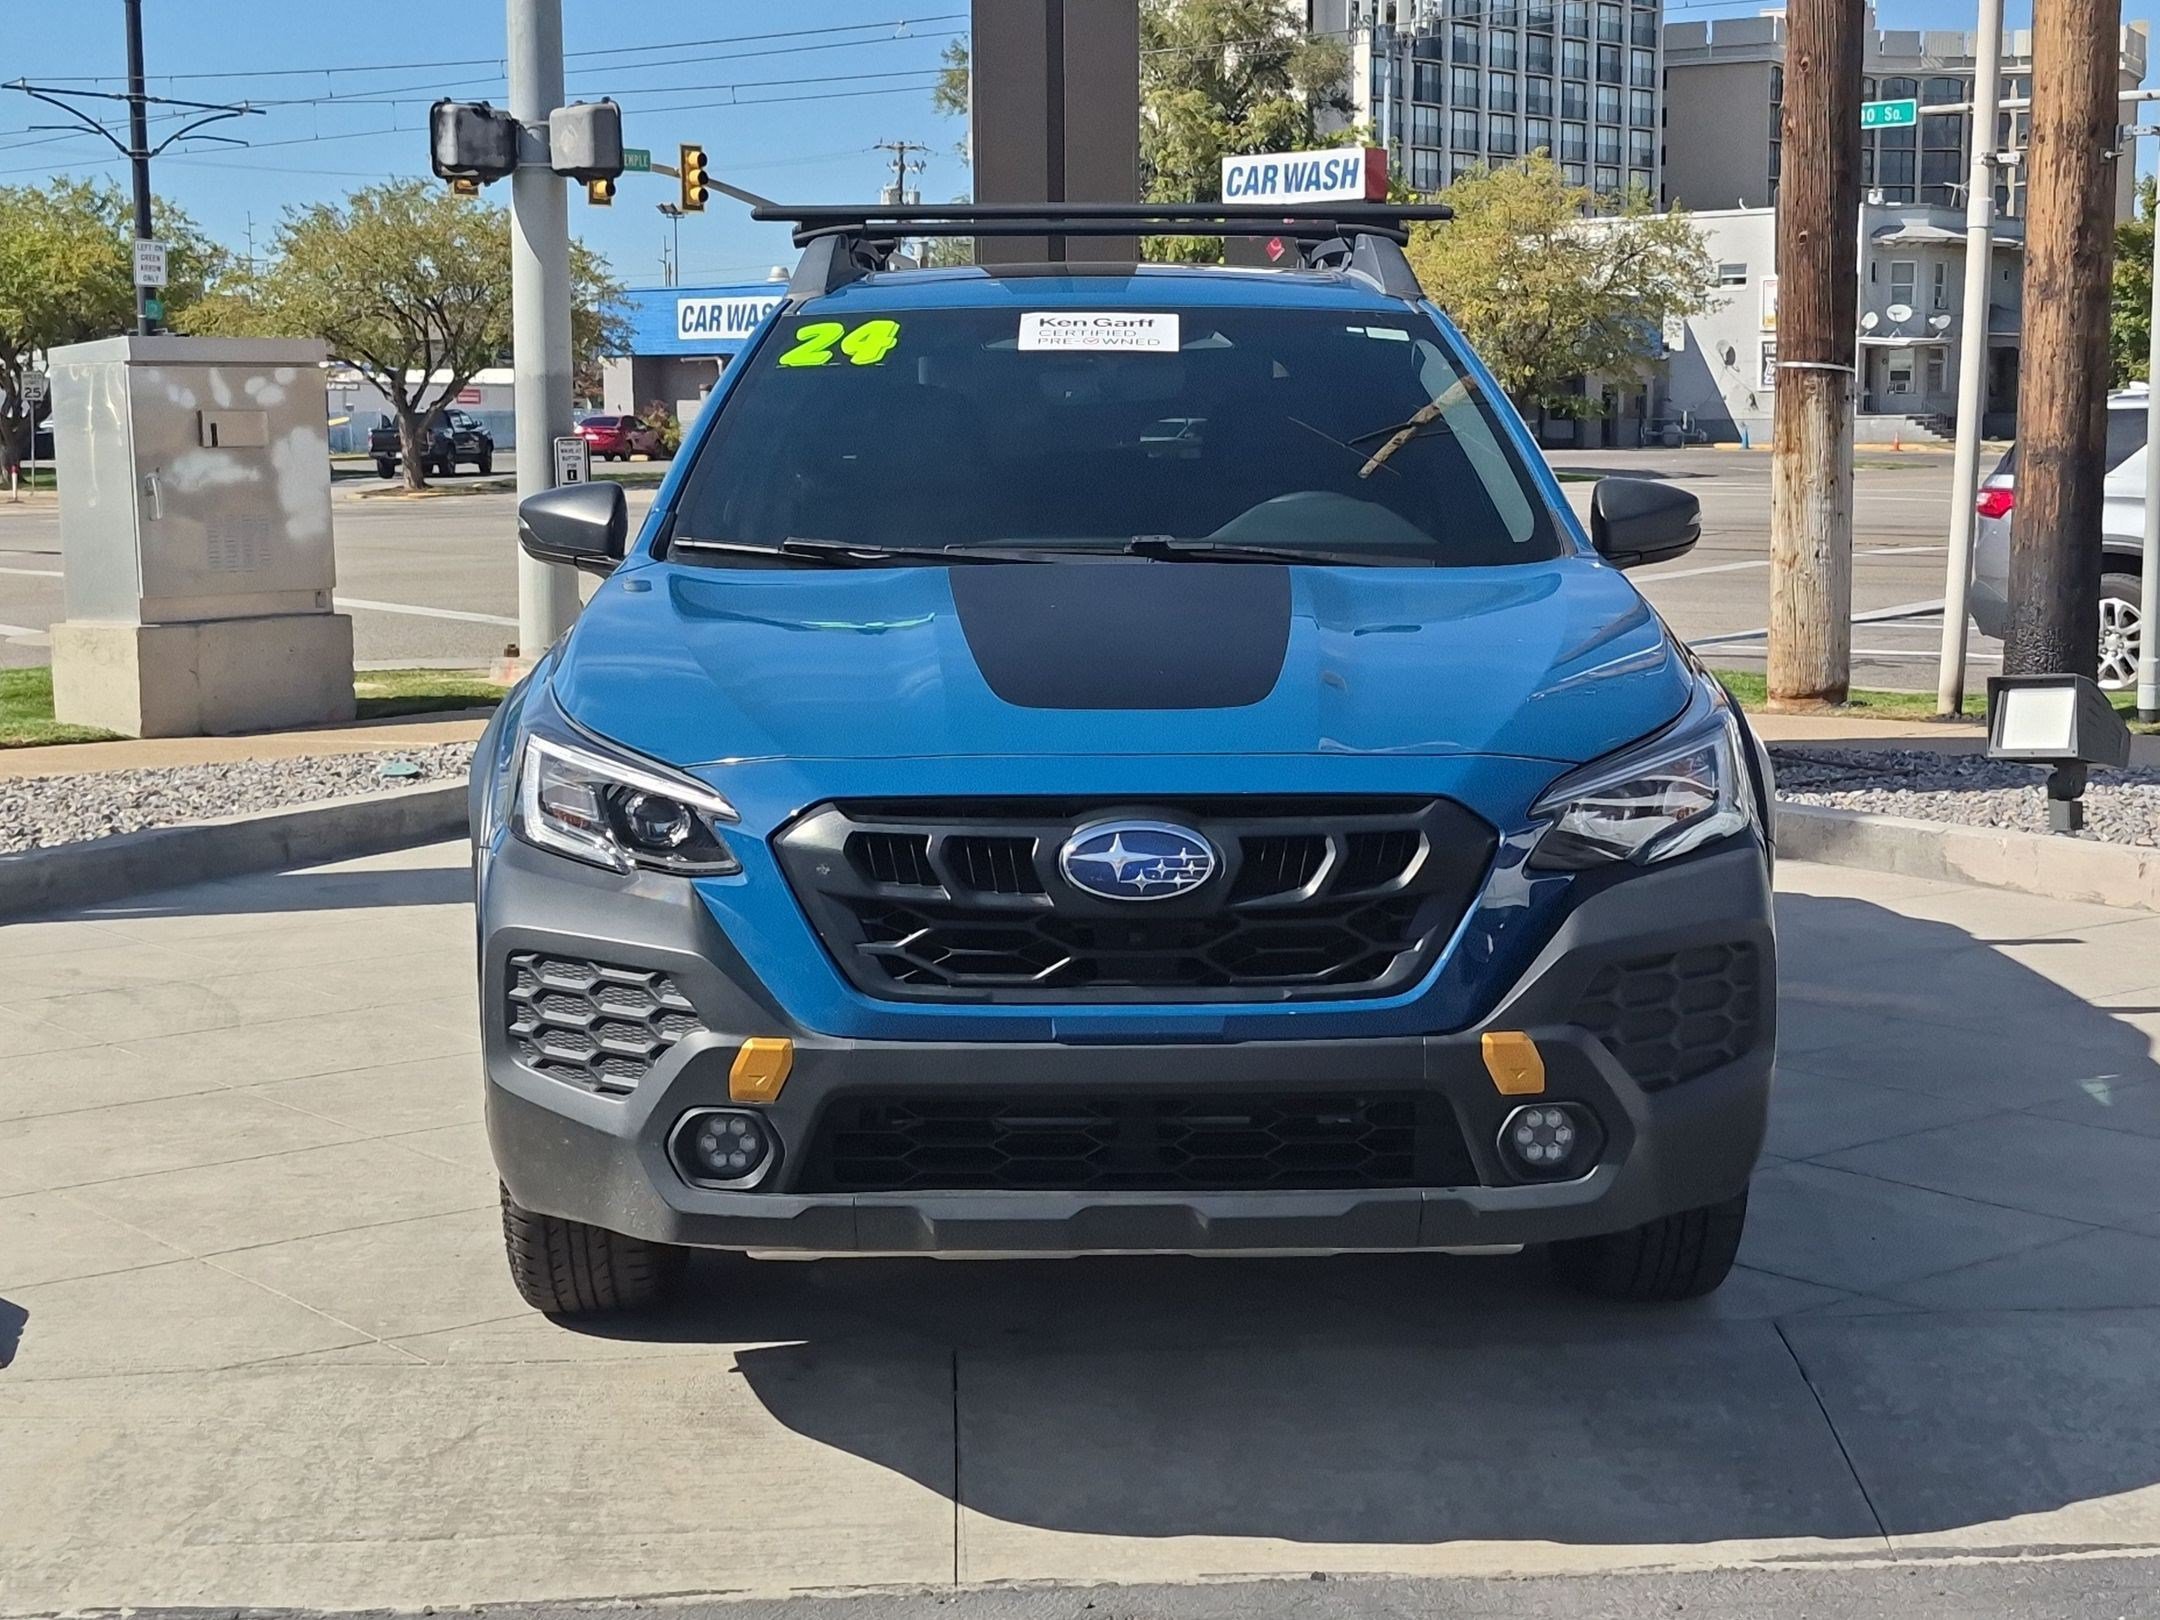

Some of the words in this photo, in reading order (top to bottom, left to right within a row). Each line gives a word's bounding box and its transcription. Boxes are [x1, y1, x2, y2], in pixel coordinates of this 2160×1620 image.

[1226, 164, 1278, 197] CAR
[1284, 157, 1360, 193] WASH
[137, 243, 152, 251] LEFT
[154, 244, 163, 252] ON
[140, 254, 161, 262] GREEN
[140, 264, 161, 272] ARROW
[142, 274, 160, 283] ONLY
[682, 305, 722, 333] CAR
[1039, 318, 1087, 327] Ken
[1093, 318, 1155, 328] Garff
[1038, 329, 1136, 337] CERTIFIED
[778, 319, 901, 368] 24
[24, 387, 41, 398] 25
